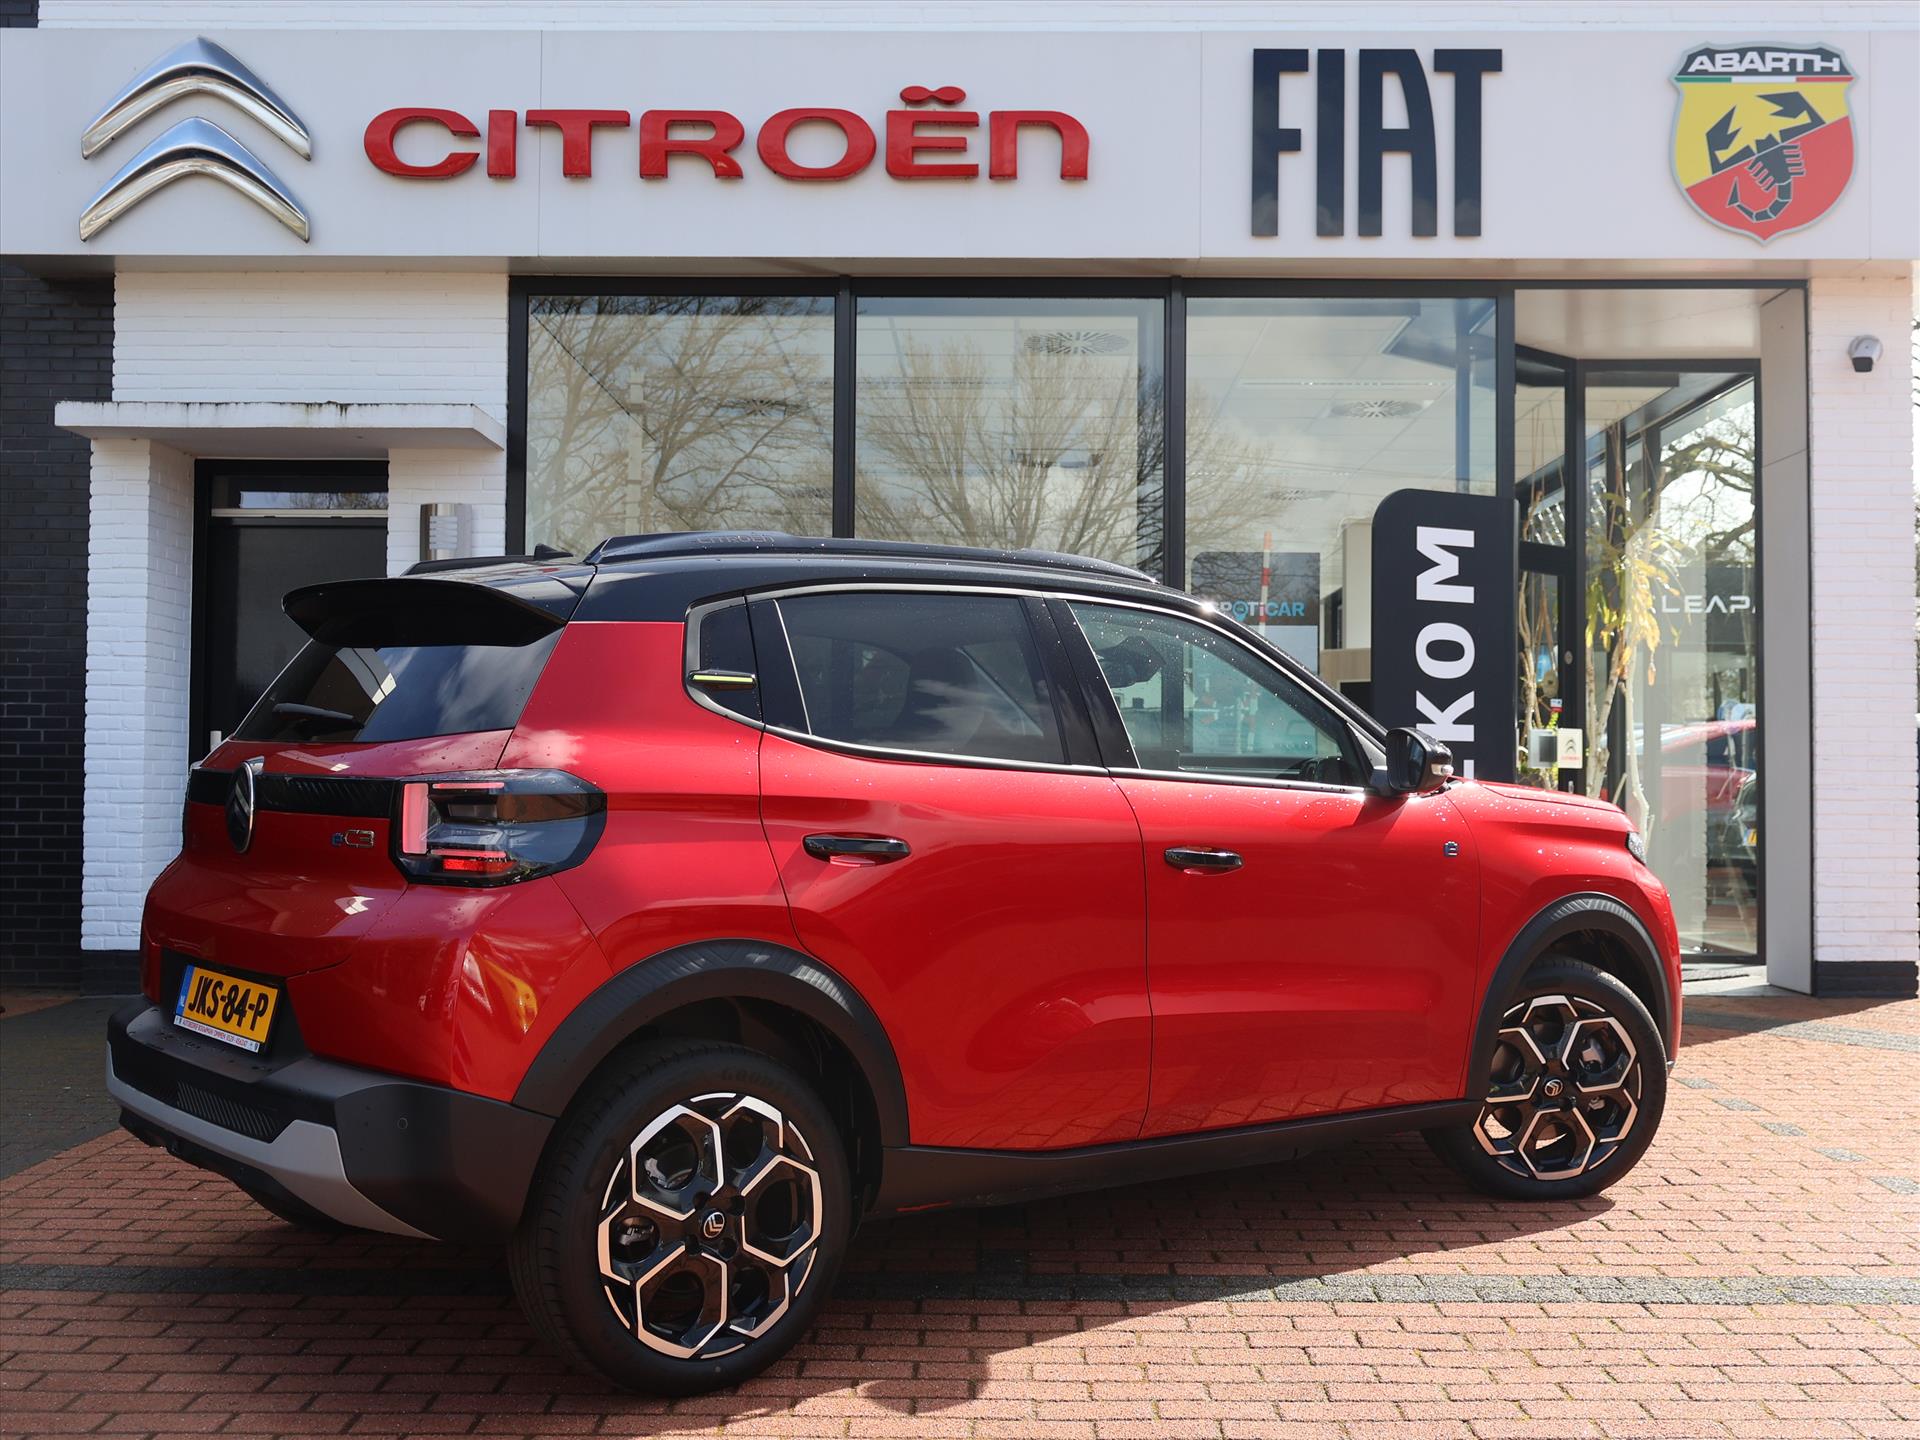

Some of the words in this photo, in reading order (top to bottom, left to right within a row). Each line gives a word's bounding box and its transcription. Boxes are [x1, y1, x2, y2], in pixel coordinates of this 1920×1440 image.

[1687, 51, 1840, 72] ABARTH
[364, 85, 1089, 180] CITROËN
[1251, 49, 1502, 236] FIAT
[1661, 594, 1756, 614] LEAP
[188, 975, 269, 1031] JKS-84-P
